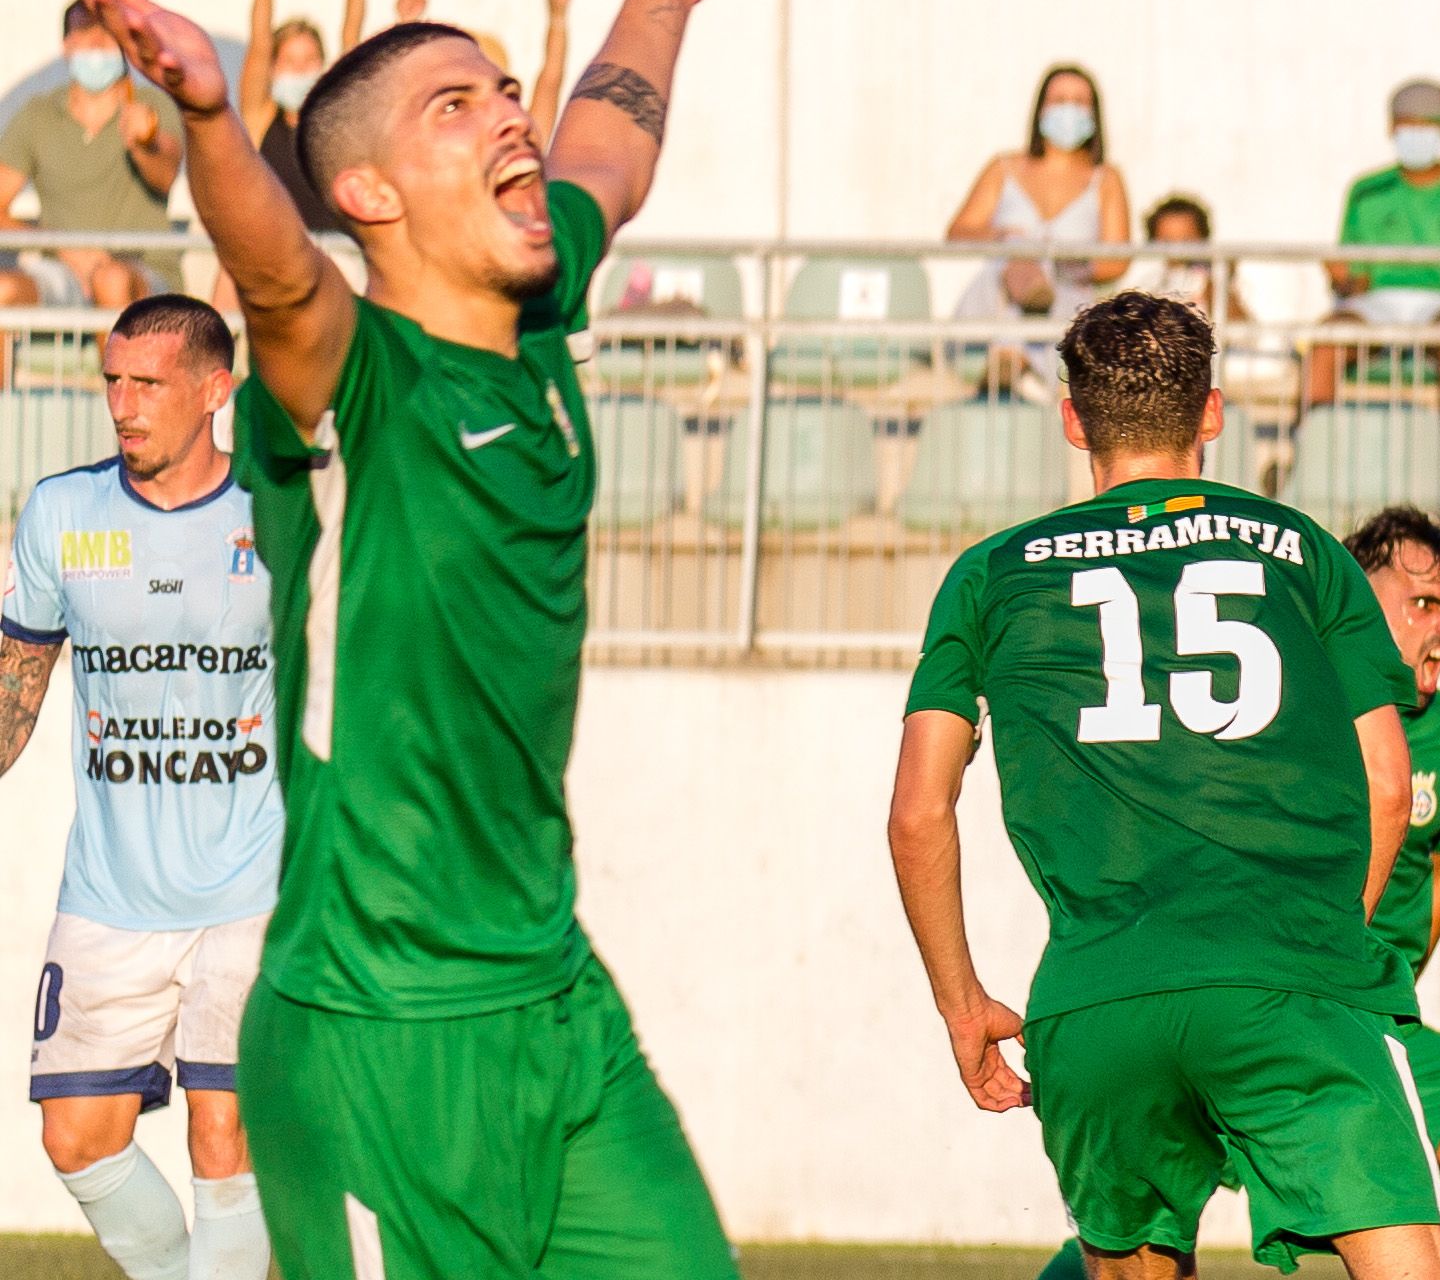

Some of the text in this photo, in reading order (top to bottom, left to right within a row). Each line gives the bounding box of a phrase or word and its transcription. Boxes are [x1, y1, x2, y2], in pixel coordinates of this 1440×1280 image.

[61, 530, 133, 569] AMB
[1024, 513, 1303, 565] SERRAMITJA
[73, 641, 268, 674] macarena
[1070, 560, 1282, 743] 15
[103, 717, 237, 741] AZULEJOS
